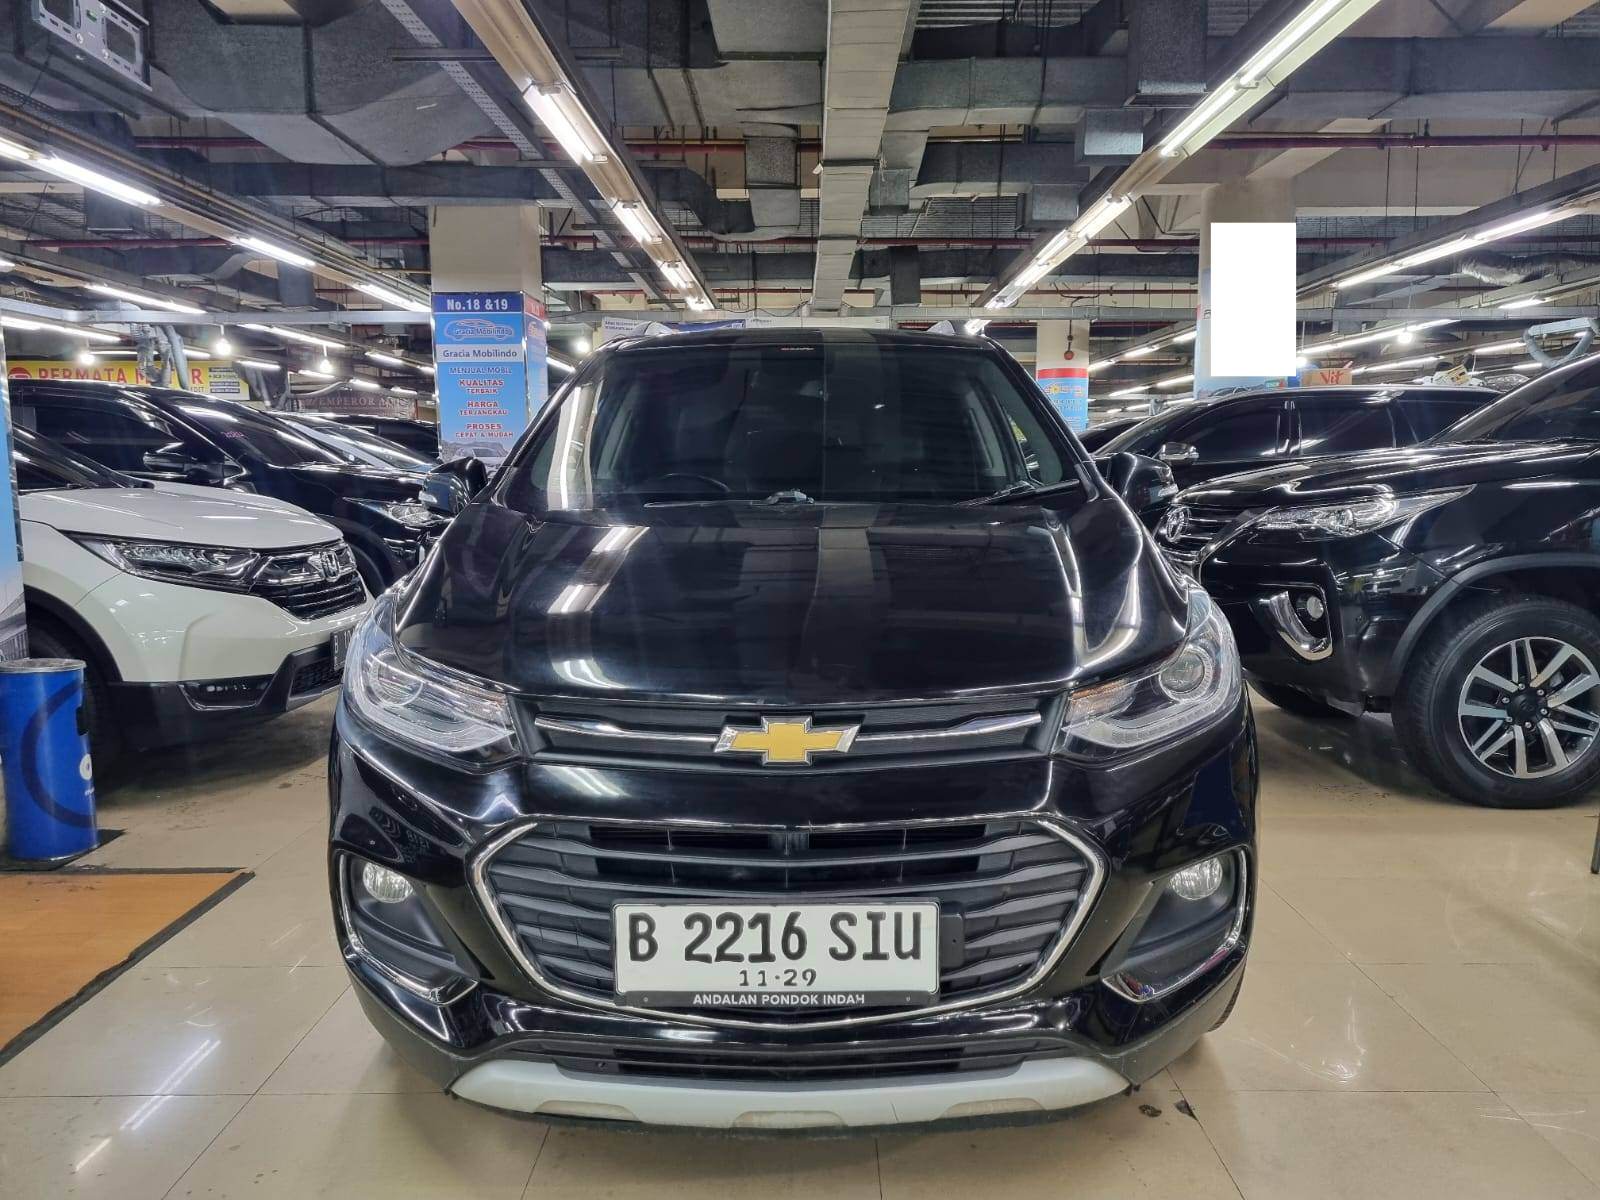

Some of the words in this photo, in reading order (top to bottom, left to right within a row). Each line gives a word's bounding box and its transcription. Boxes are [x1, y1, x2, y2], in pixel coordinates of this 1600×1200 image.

[447, 299, 480, 311] No.18
[484, 299, 508, 311] &19
[443, 349, 470, 358] Gracia
[473, 349, 517, 358] Mobilindo
[38, 367, 127, 383] PERMATA
[1319, 370, 1343, 385] Vit
[320, 397, 376, 406] EMPEROR
[628, 911, 658, 962] B
[684, 911, 808, 964] 2216
[828, 911, 922, 962] SIU
[693, 994, 757, 1005] ANDALAN
[762, 994, 818, 1005] PONDOK
[823, 994, 865, 1005] INDAH
